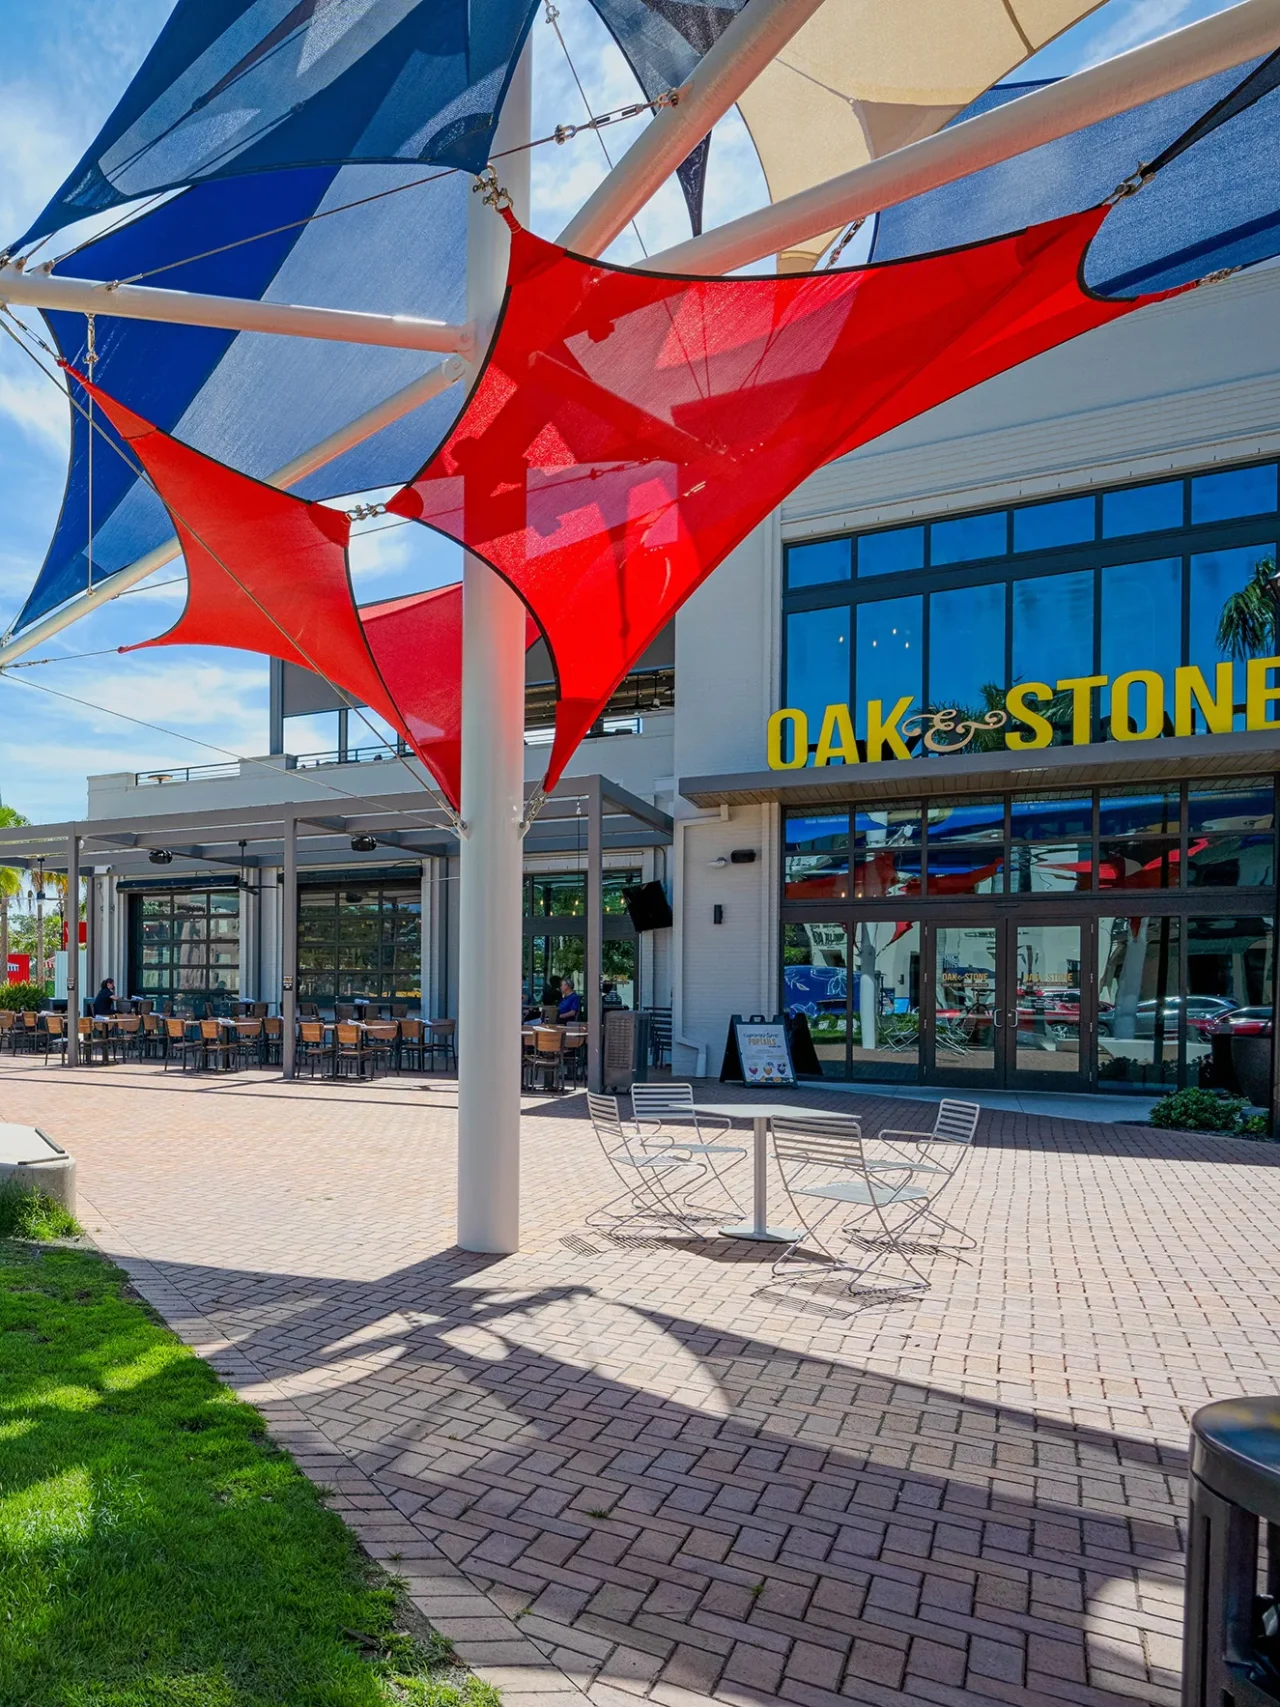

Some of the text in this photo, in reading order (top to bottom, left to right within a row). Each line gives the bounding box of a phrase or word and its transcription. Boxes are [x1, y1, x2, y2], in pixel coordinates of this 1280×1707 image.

[767, 656, 1280, 771] OAK & STONE
[942, 973, 958, 981] OAK
[964, 973, 989, 981] STONE
